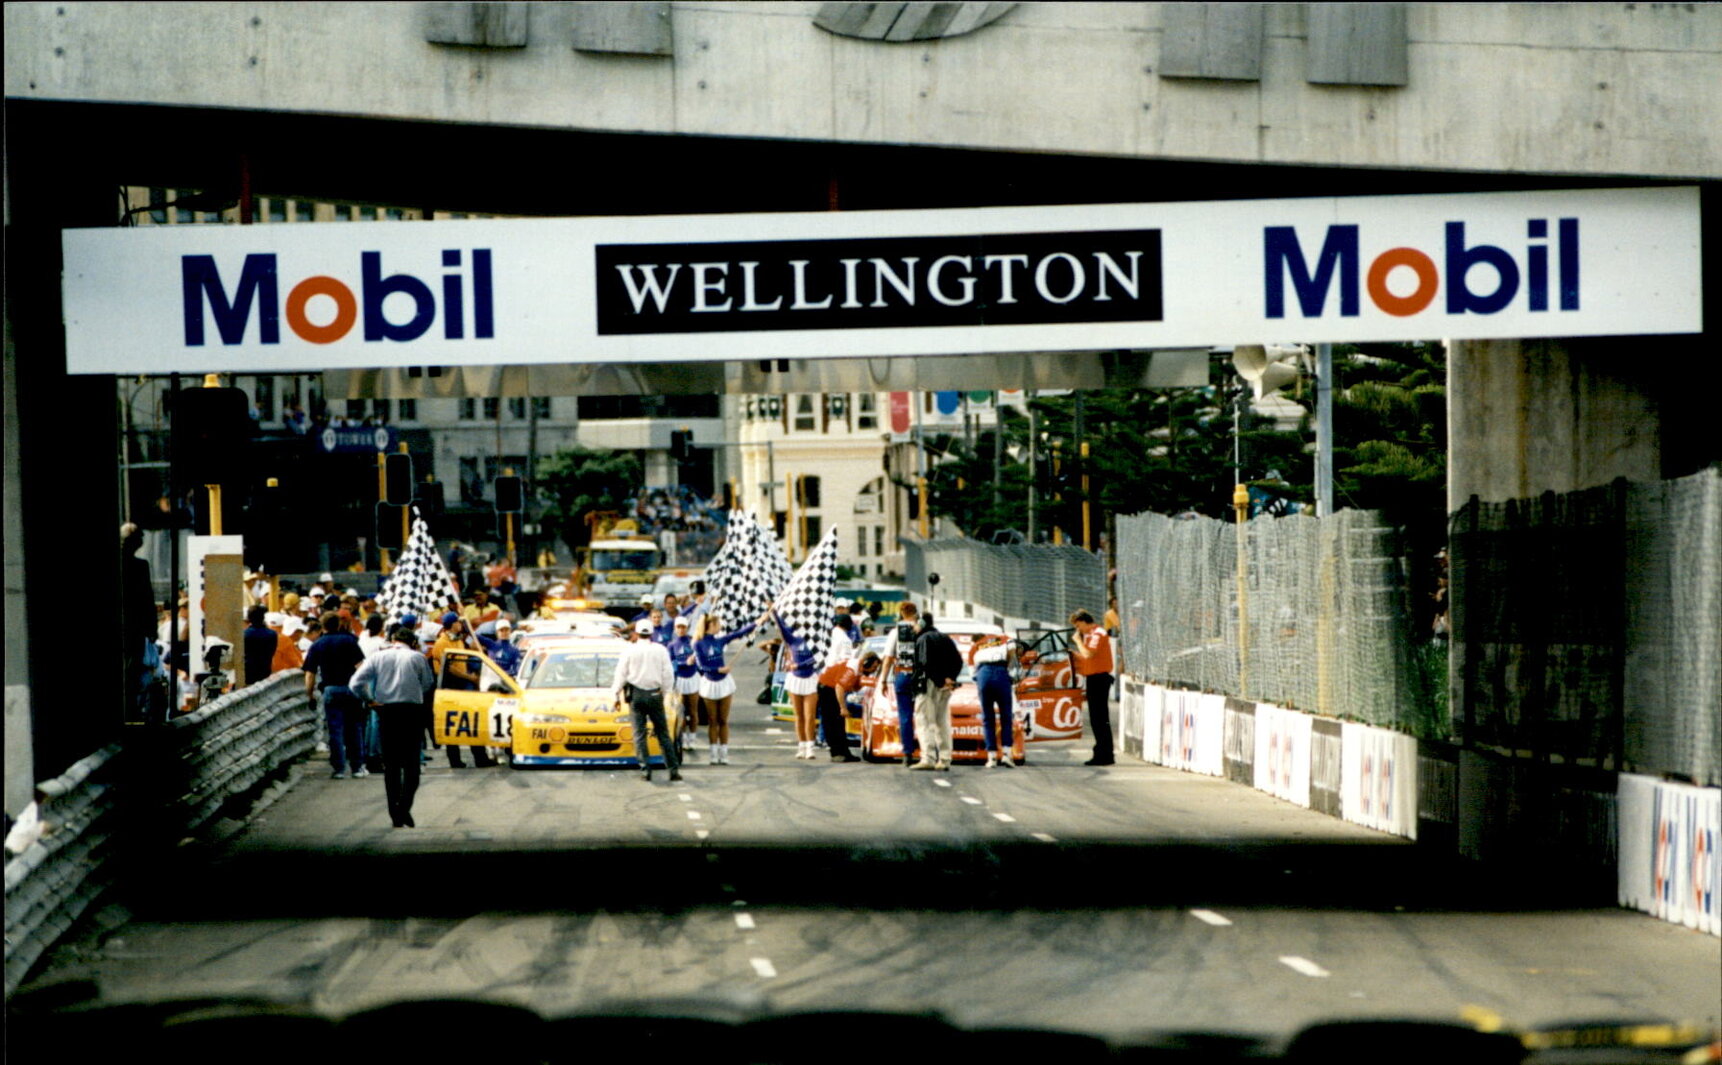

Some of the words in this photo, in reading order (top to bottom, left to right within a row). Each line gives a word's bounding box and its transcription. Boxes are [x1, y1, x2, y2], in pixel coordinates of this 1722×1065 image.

[615, 249, 1145, 317] WELLINGTON
[1264, 217, 1580, 320] Mobil
[182, 248, 496, 347] Mobil
[445, 711, 479, 737] FAI
[1053, 696, 1082, 729] Co
[532, 728, 548, 739] FAI
[567, 735, 617, 743] DUNLOP
